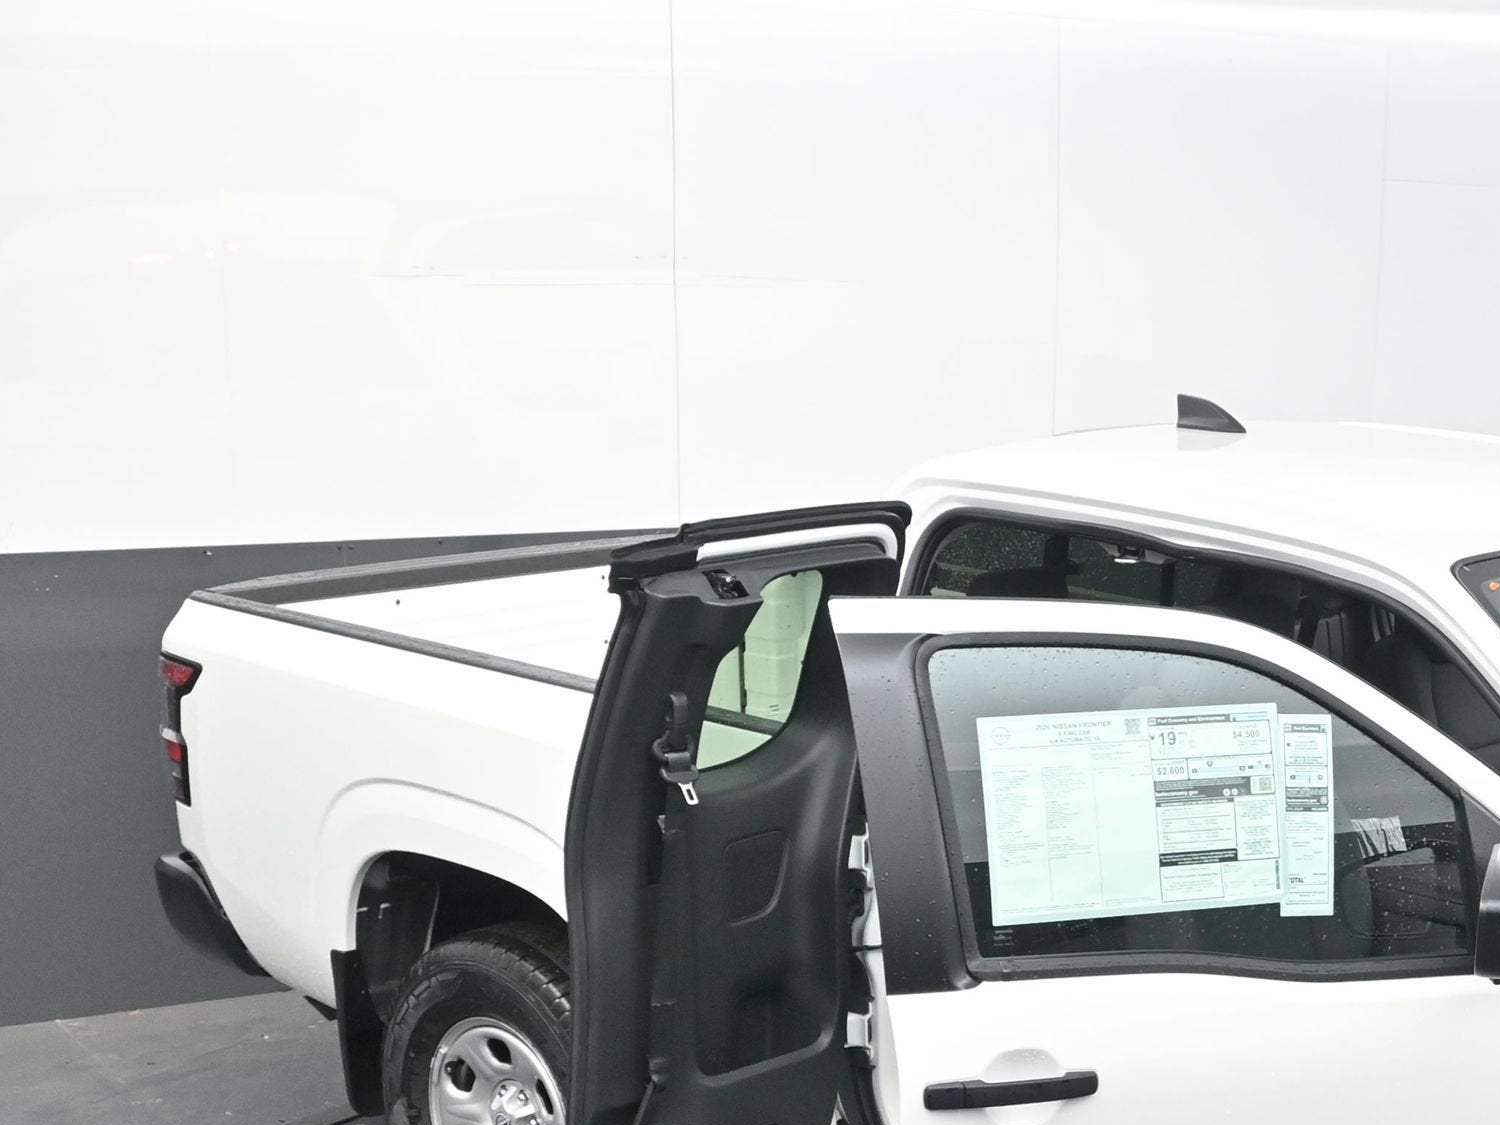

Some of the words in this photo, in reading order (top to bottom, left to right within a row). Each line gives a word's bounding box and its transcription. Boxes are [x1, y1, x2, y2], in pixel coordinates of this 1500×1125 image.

[1052, 722, 1077, 730] NISSAN
[1078, 720, 1112, 729] FRONTIER
[1158, 731, 1176, 746] 19
[1157, 766, 1185, 776] $2,600
